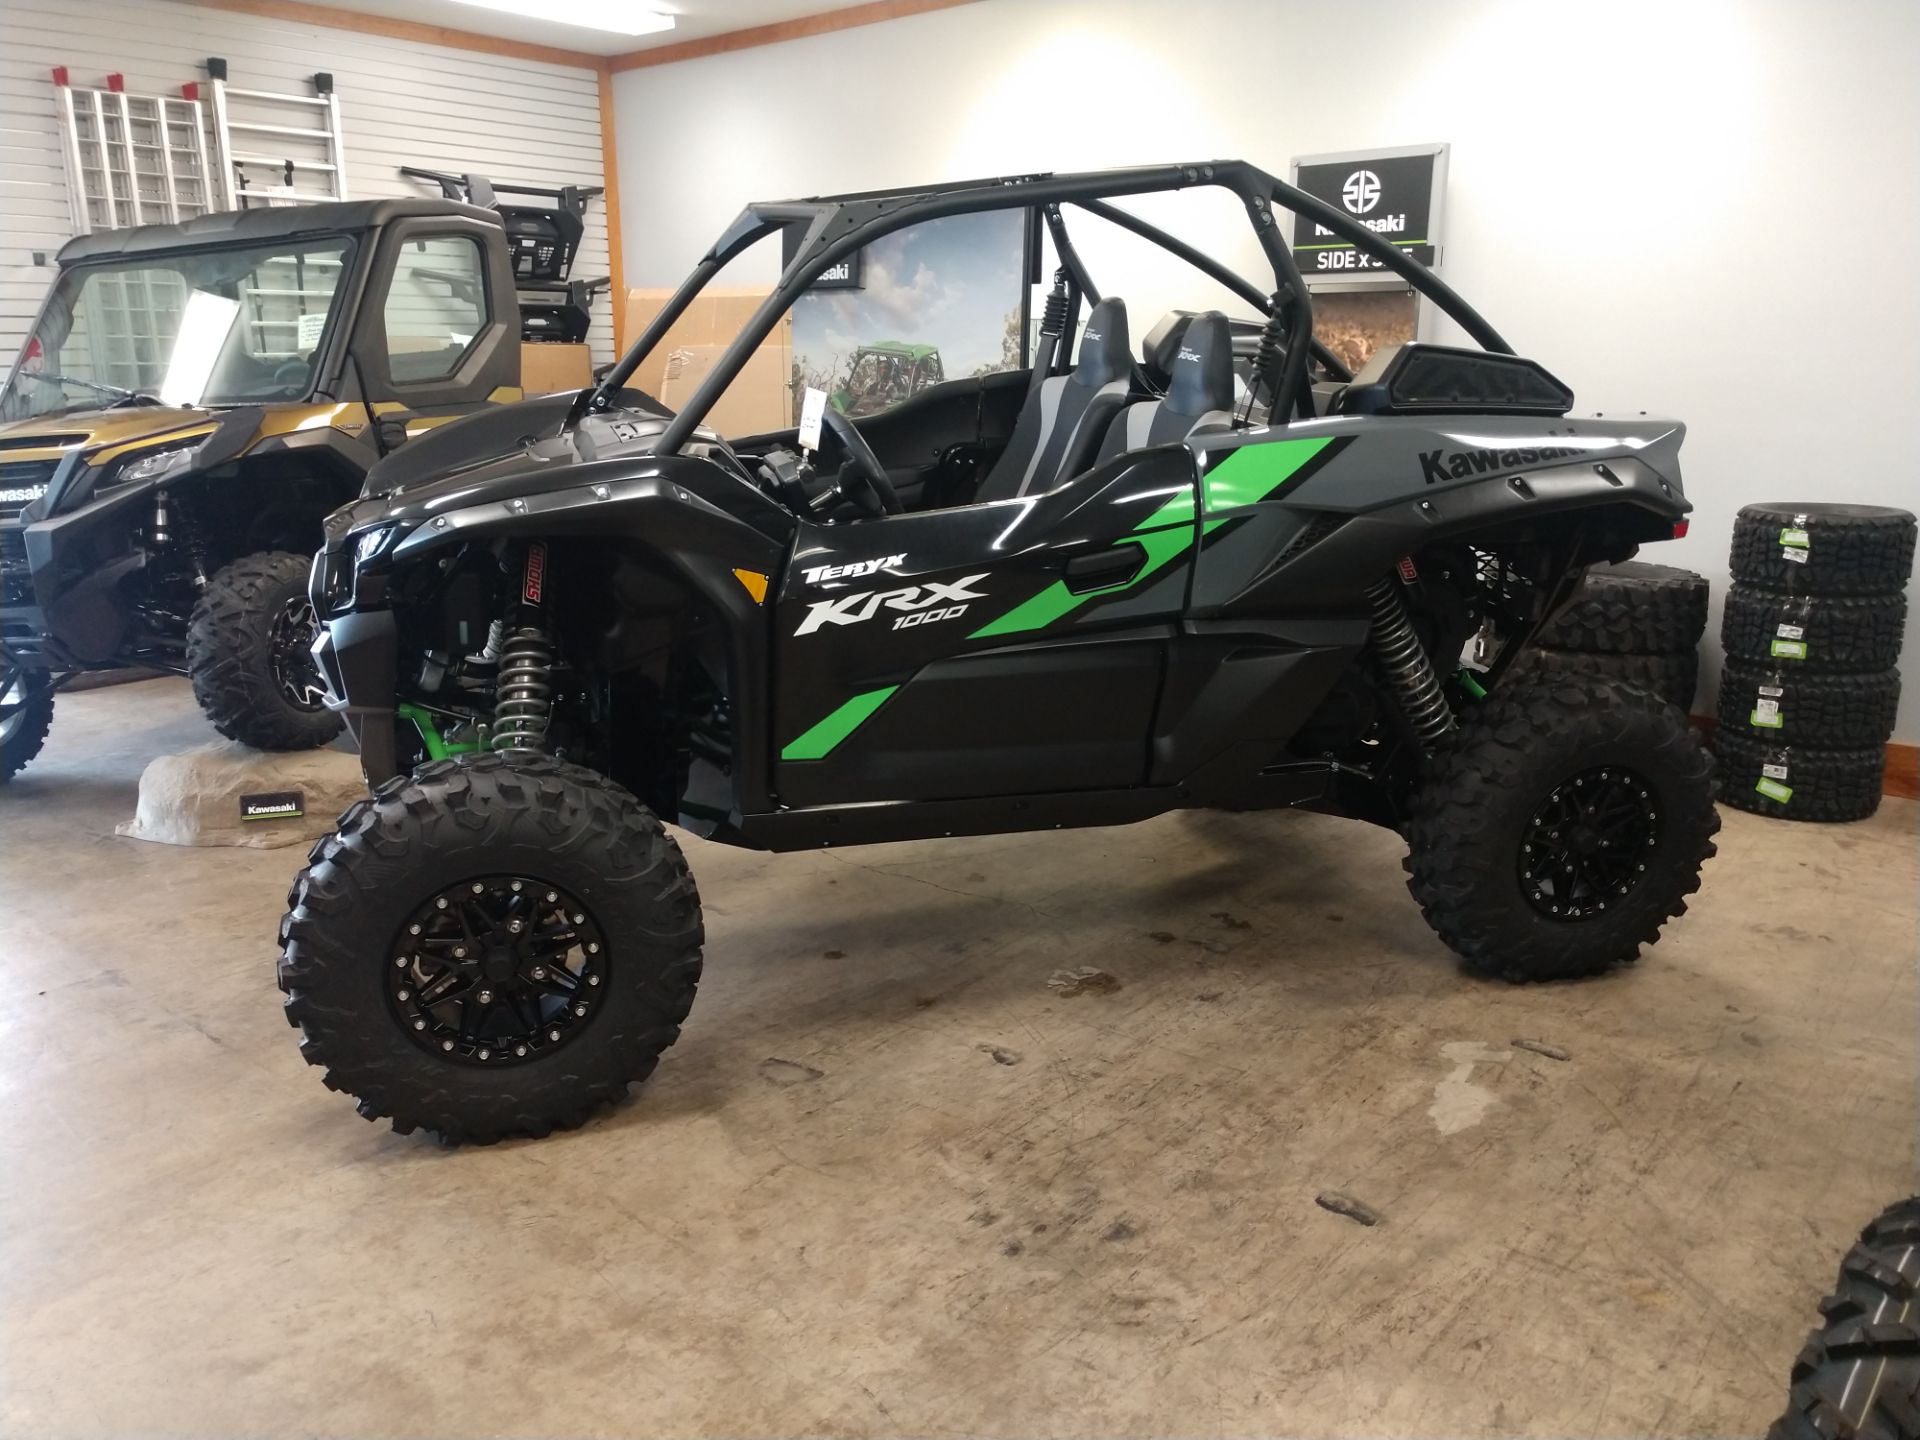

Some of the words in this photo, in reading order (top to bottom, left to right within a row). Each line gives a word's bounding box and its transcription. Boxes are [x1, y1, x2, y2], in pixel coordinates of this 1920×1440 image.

[1315, 214, 1405, 236] Ksaki
[1317, 251, 1356, 269] SIDE
[816, 264, 849, 280] saki
[0, 484, 48, 501] wasaki
[793, 572, 992, 637] KRX
[892, 604, 970, 631] 1000
[248, 803, 296, 814] Kawasaki
